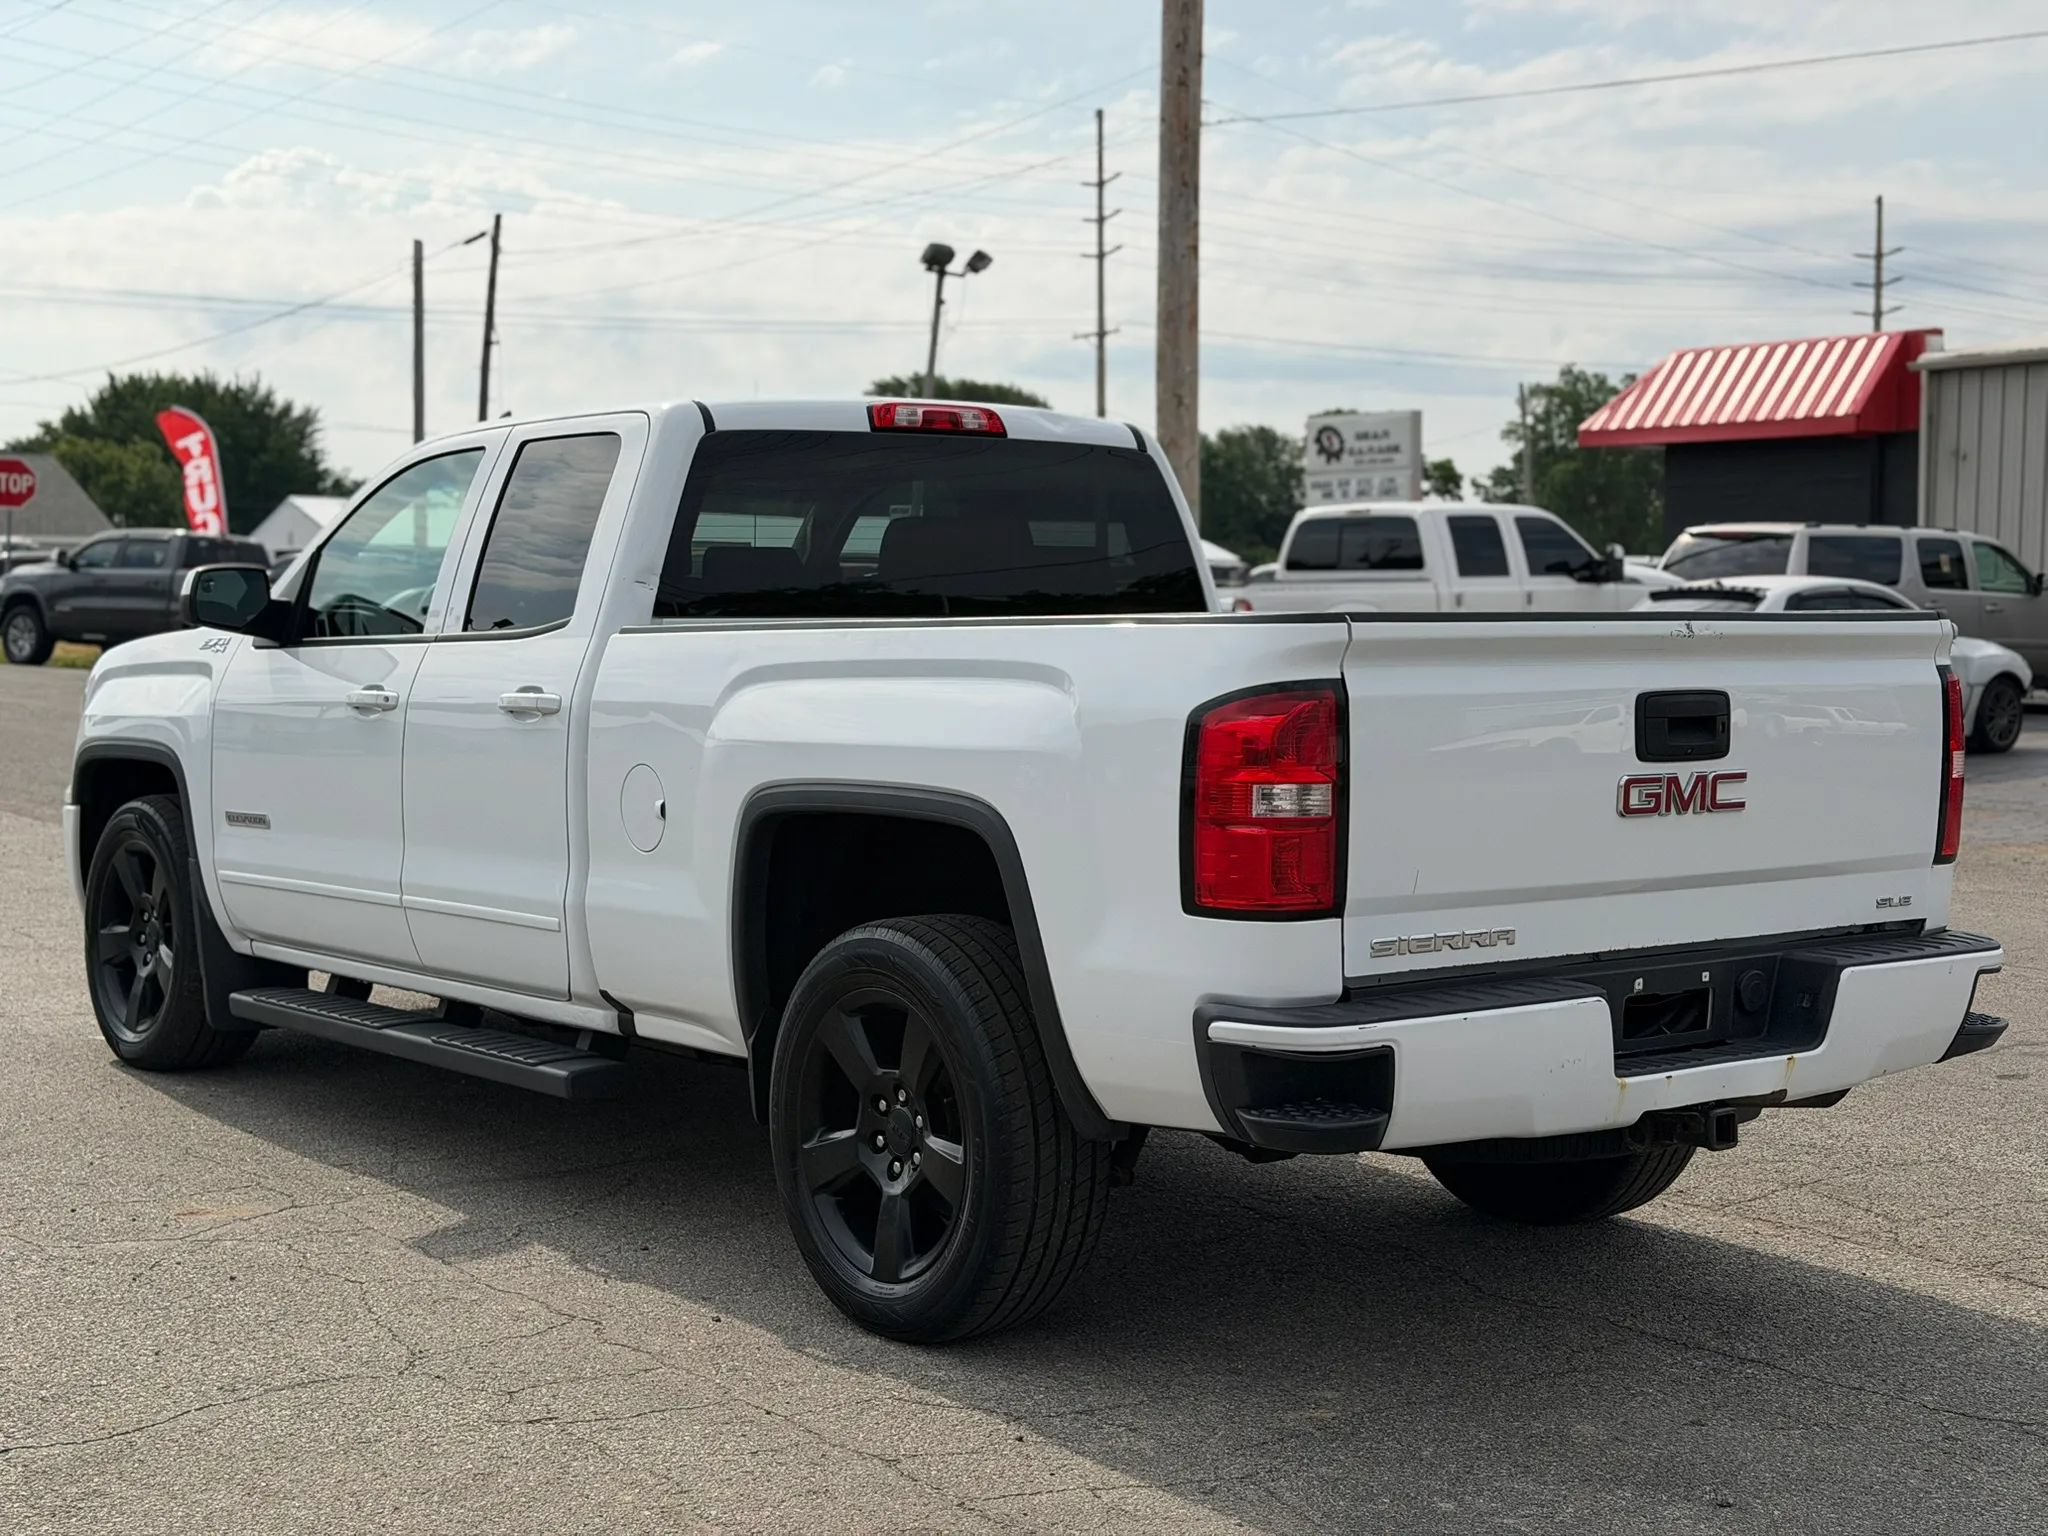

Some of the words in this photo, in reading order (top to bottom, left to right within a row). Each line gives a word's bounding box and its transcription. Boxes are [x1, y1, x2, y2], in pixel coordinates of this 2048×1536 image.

[1616, 769, 1748, 817] GMC
[1875, 895, 1912, 909] SLE
[1370, 926, 1516, 958] SIERRA
